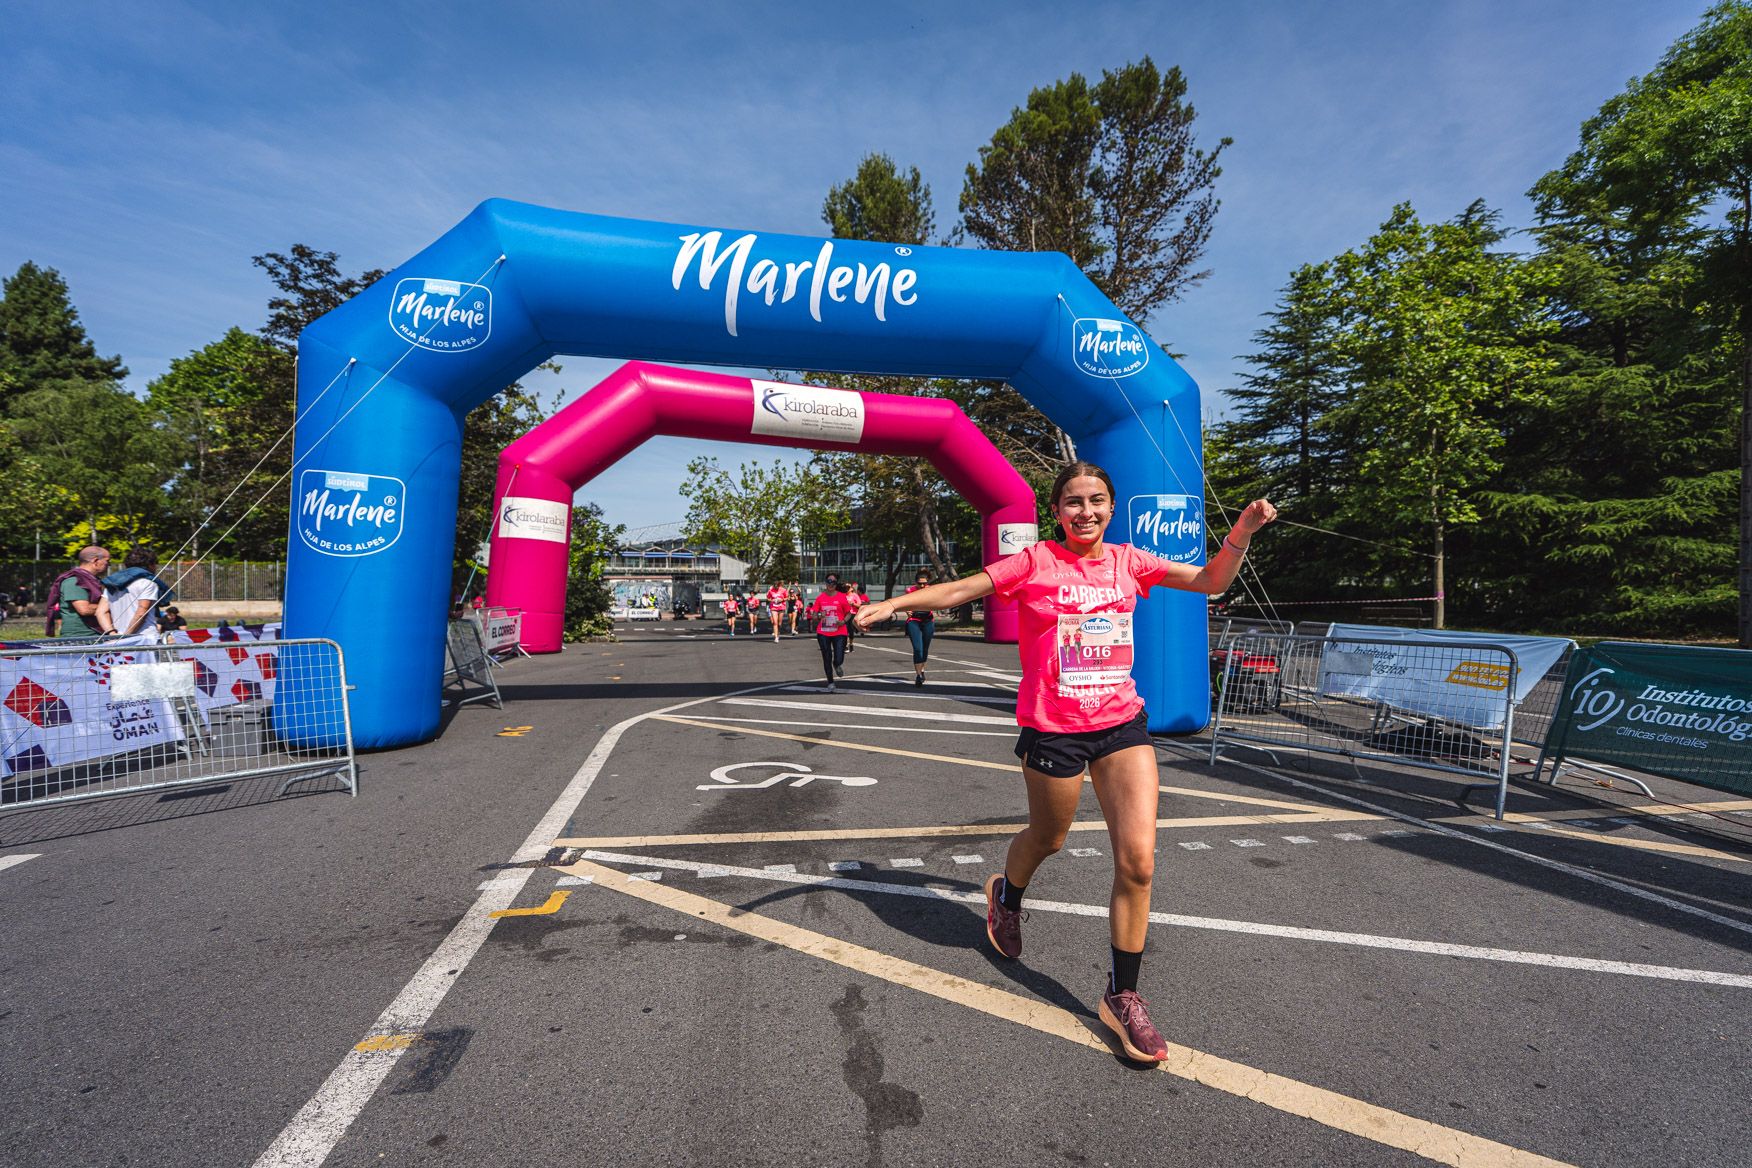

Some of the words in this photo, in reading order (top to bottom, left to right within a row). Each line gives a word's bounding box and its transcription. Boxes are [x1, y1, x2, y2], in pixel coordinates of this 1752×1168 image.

[399, 324, 417, 339] HIJA
[418, 335, 430, 344] DE
[452, 336, 477, 347] ALPES
[1083, 361, 1096, 372] HIJA
[1123, 360, 1141, 373] ALPES
[784, 397, 857, 418] kirolaraba
[516, 511, 565, 526] kirolaraba
[304, 528, 319, 544] HIJA
[320, 539, 332, 549] DE
[333, 543, 353, 551] LOS
[355, 536, 385, 551] ALPES
[1184, 546, 1199, 560] ALPES
[1058, 584, 1125, 604] CARRERA
[492, 627, 498, 638] EL
[498, 624, 516, 637] CORREO
[1082, 646, 1111, 658] 016
[106, 699, 150, 711] Experience
[1080, 697, 1100, 709] 2026
[1636, 684, 1752, 713] Institutos
[1626, 703, 1752, 741] Odontológ
[113, 722, 159, 740] OMAN
[1657, 732, 1709, 749] dentales
